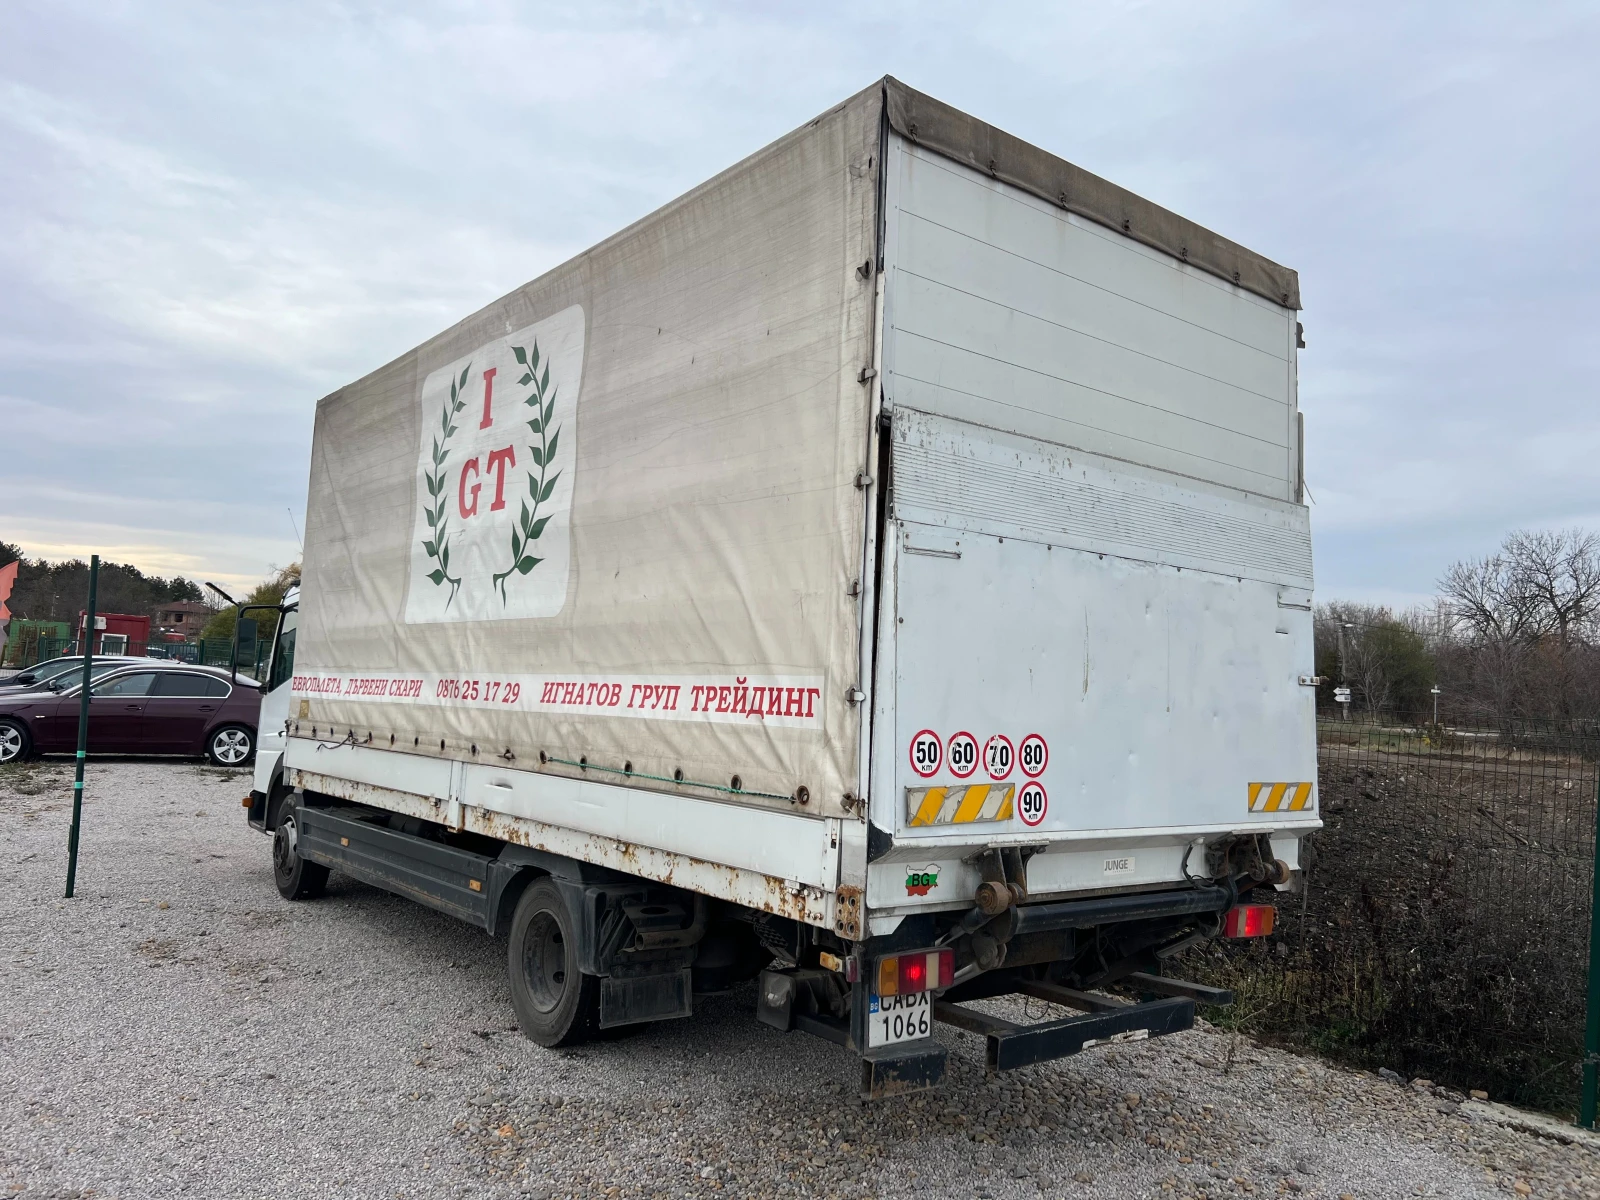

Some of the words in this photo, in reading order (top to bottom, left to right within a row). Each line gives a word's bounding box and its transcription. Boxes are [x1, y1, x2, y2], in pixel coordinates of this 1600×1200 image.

[479, 367, 497, 430] I
[458, 444, 516, 520] GT
[344, 678, 389, 696] ДЪРВЕНИ
[389, 679, 423, 697] СКАРИ
[436, 679, 460, 699] 0876
[462, 680, 480, 701] 25
[483, 681, 500, 702] 17
[502, 682, 521, 703] 29
[540, 682, 623, 706] ИГНАТОВ
[627, 684, 681, 711] ГРУП
[690, 676, 820, 719] ТРЕЙДИНГ
[916, 741, 938, 764] 50
[952, 742, 974, 765] 60
[989, 745, 1009, 767] 70
[1024, 744, 1043, 765] 80
[1023, 791, 1042, 813] 90
[1104, 859, 1129, 872] JUNGE
[911, 873, 930, 887] BG
[882, 1010, 929, 1041] 1066
